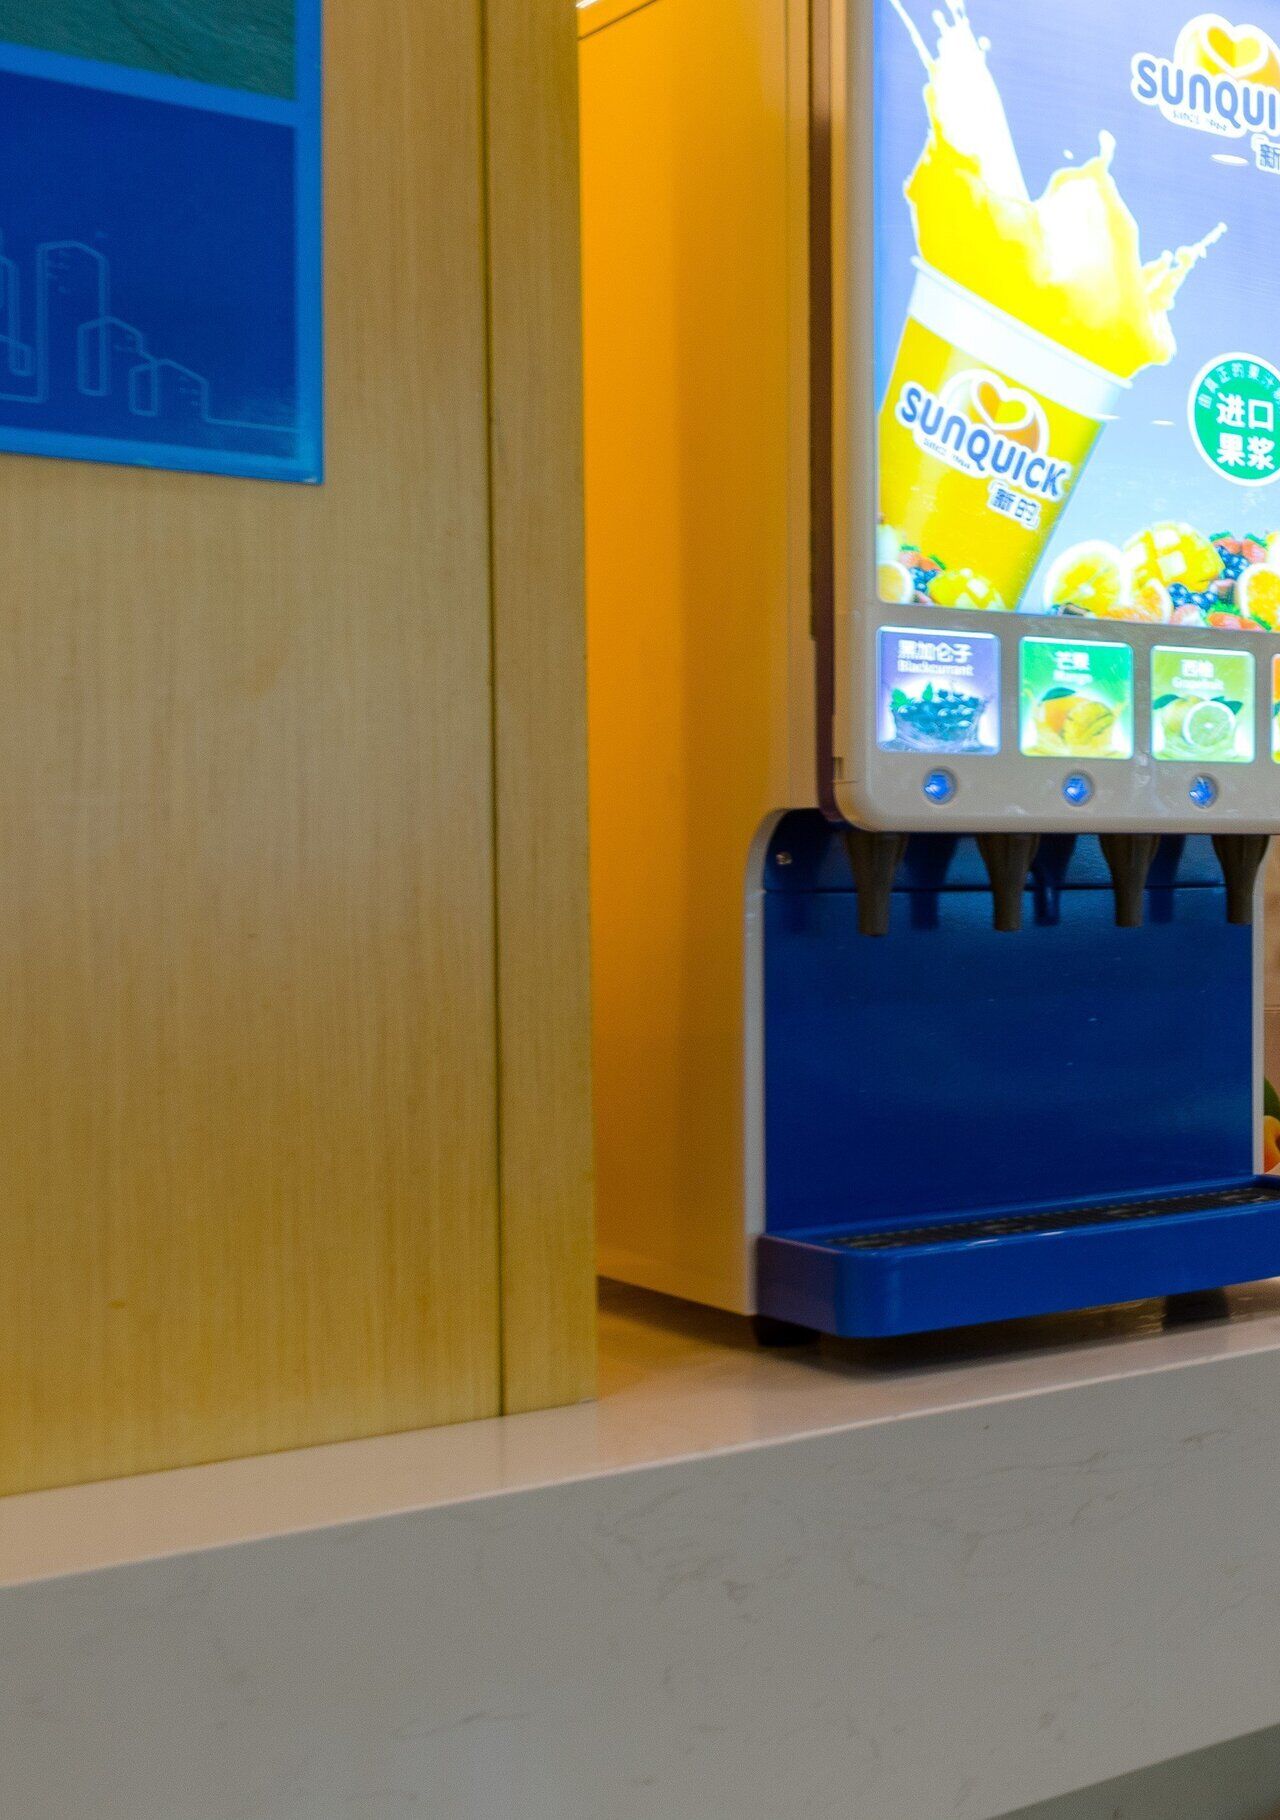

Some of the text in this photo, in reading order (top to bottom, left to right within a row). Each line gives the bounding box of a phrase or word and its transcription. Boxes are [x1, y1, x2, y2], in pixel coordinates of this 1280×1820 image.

[1216, 392, 1274, 432] 进口
[901, 387, 1067, 498] SUNQUICK
[1216, 432, 1275, 470] 果浆
